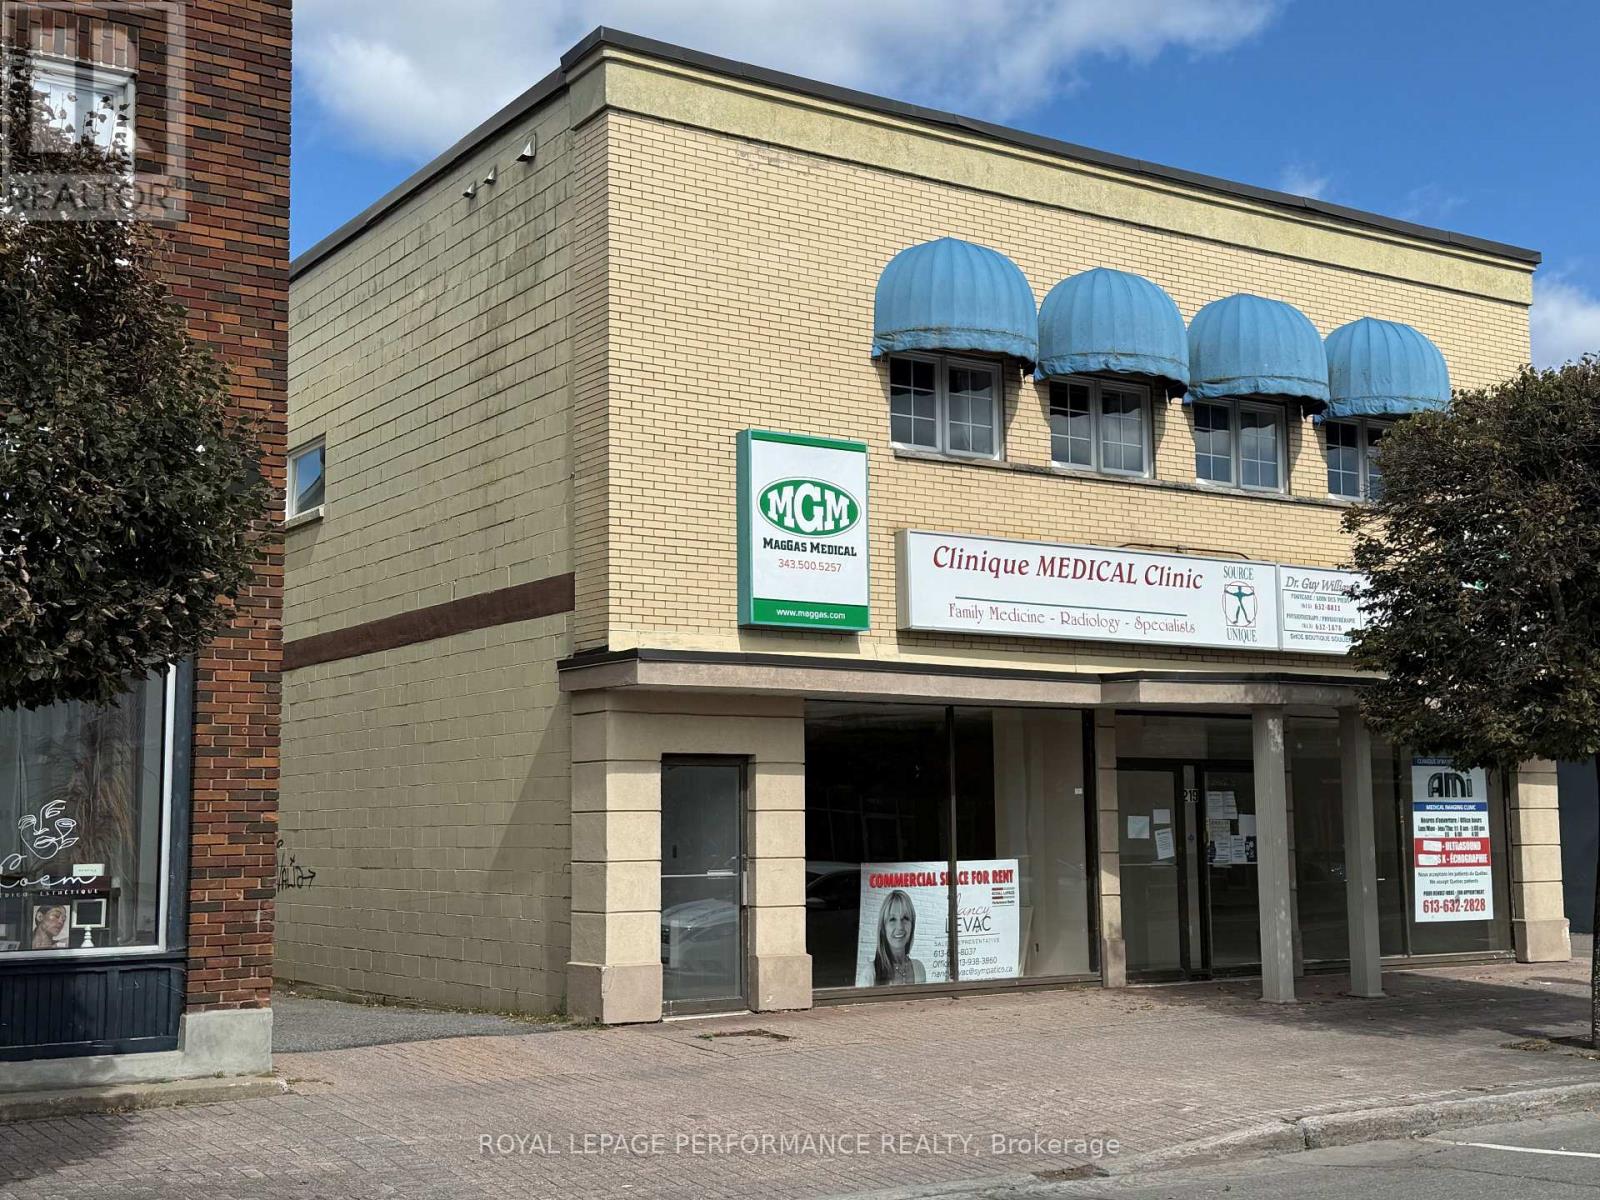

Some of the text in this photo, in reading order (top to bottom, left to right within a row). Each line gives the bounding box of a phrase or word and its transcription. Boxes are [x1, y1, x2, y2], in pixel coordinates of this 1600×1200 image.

[767, 482, 850, 533] MGM
[778, 559, 842, 573] 343.500.5257
[933, 545, 1204, 590] Clinique MEDICAL Clinic
[1223, 565, 1254, 581] SOURCE
[1285, 576, 1300, 588] Dr.
[1301, 577, 1320, 594] Guy
[776, 608, 846, 620] www.maggas.com
[948, 603, 983, 624] Family
[989, 606, 1046, 625] Medicine
[1060, 611, 1121, 631] Radiology
[1134, 615, 1197, 634] Specialists
[1226, 627, 1258, 643] UNIQUE
[869, 869, 1014, 889] COMMERCIAL SCE FOR RENT
[1423, 898, 1486, 913] 613-632-2828
